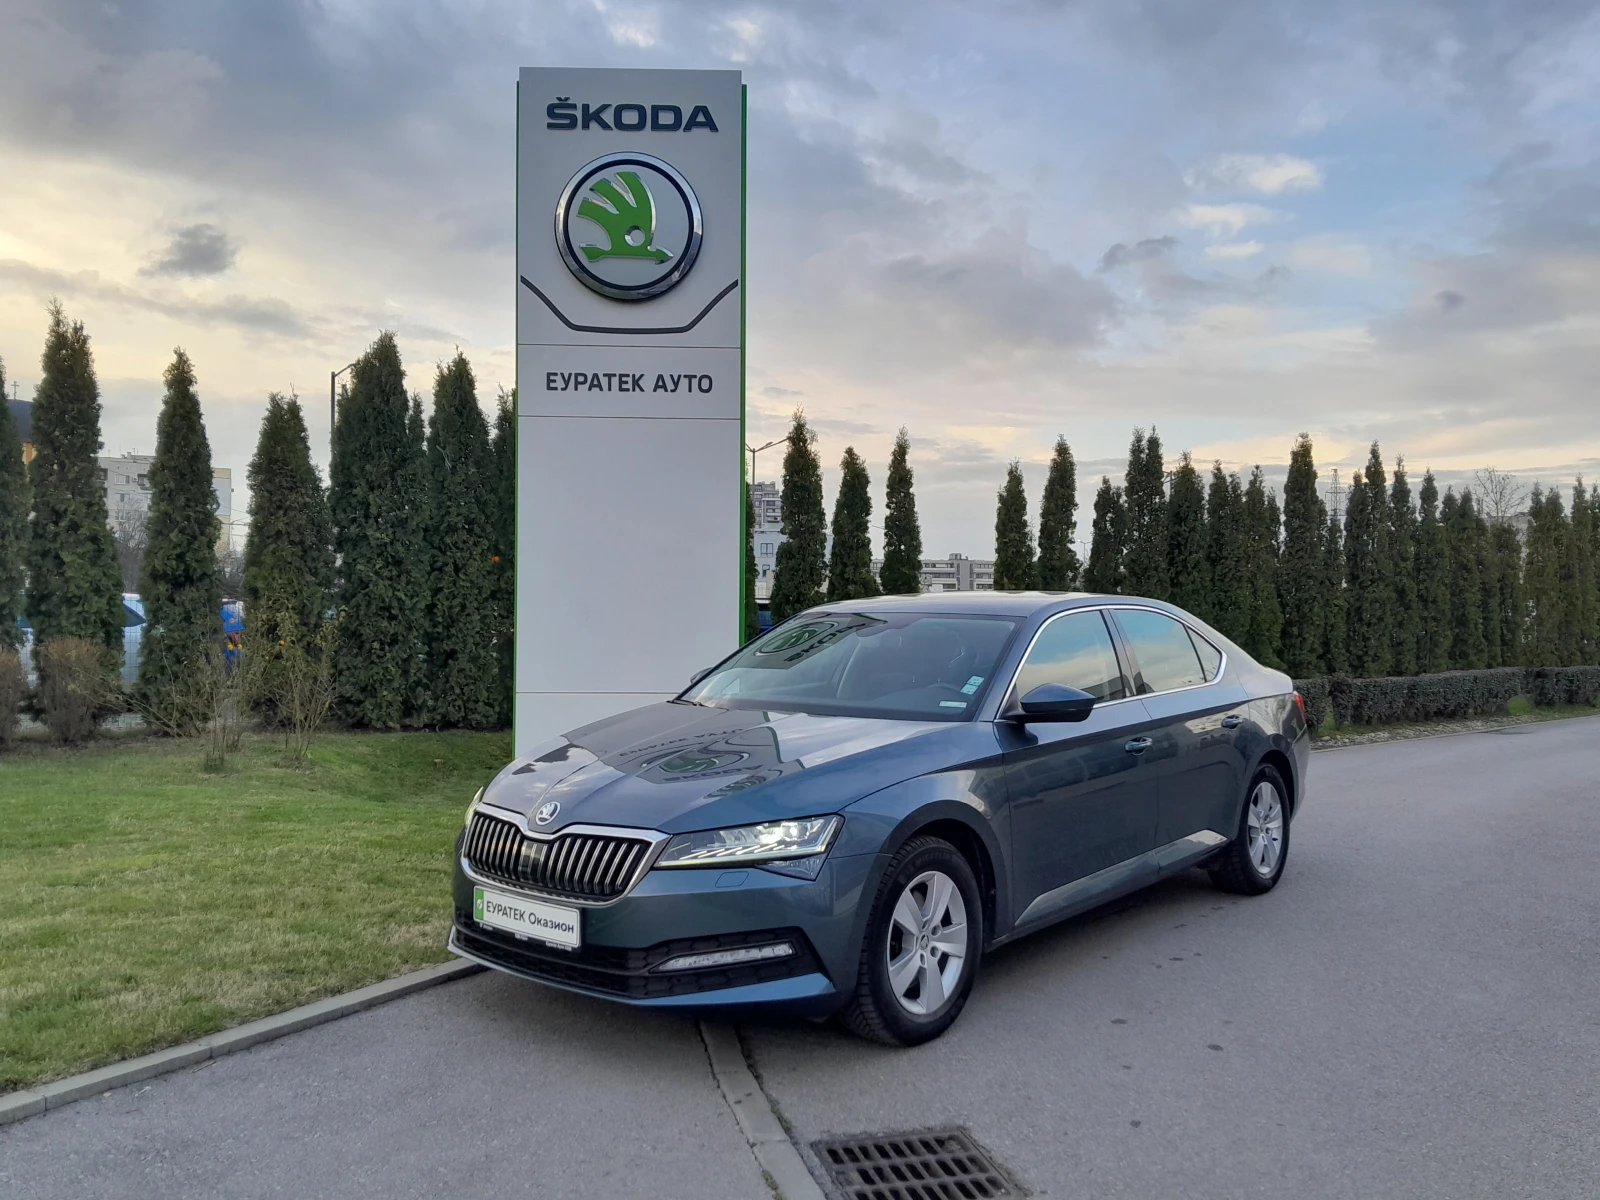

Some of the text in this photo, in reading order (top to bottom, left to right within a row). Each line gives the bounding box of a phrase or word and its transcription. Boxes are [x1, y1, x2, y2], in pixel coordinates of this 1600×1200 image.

[546, 96, 719, 133] ŠKODA
[546, 372, 713, 394] ЕУРАТЕК АУТО
[486, 900, 575, 935] ЕУРАТЕК Оказион
